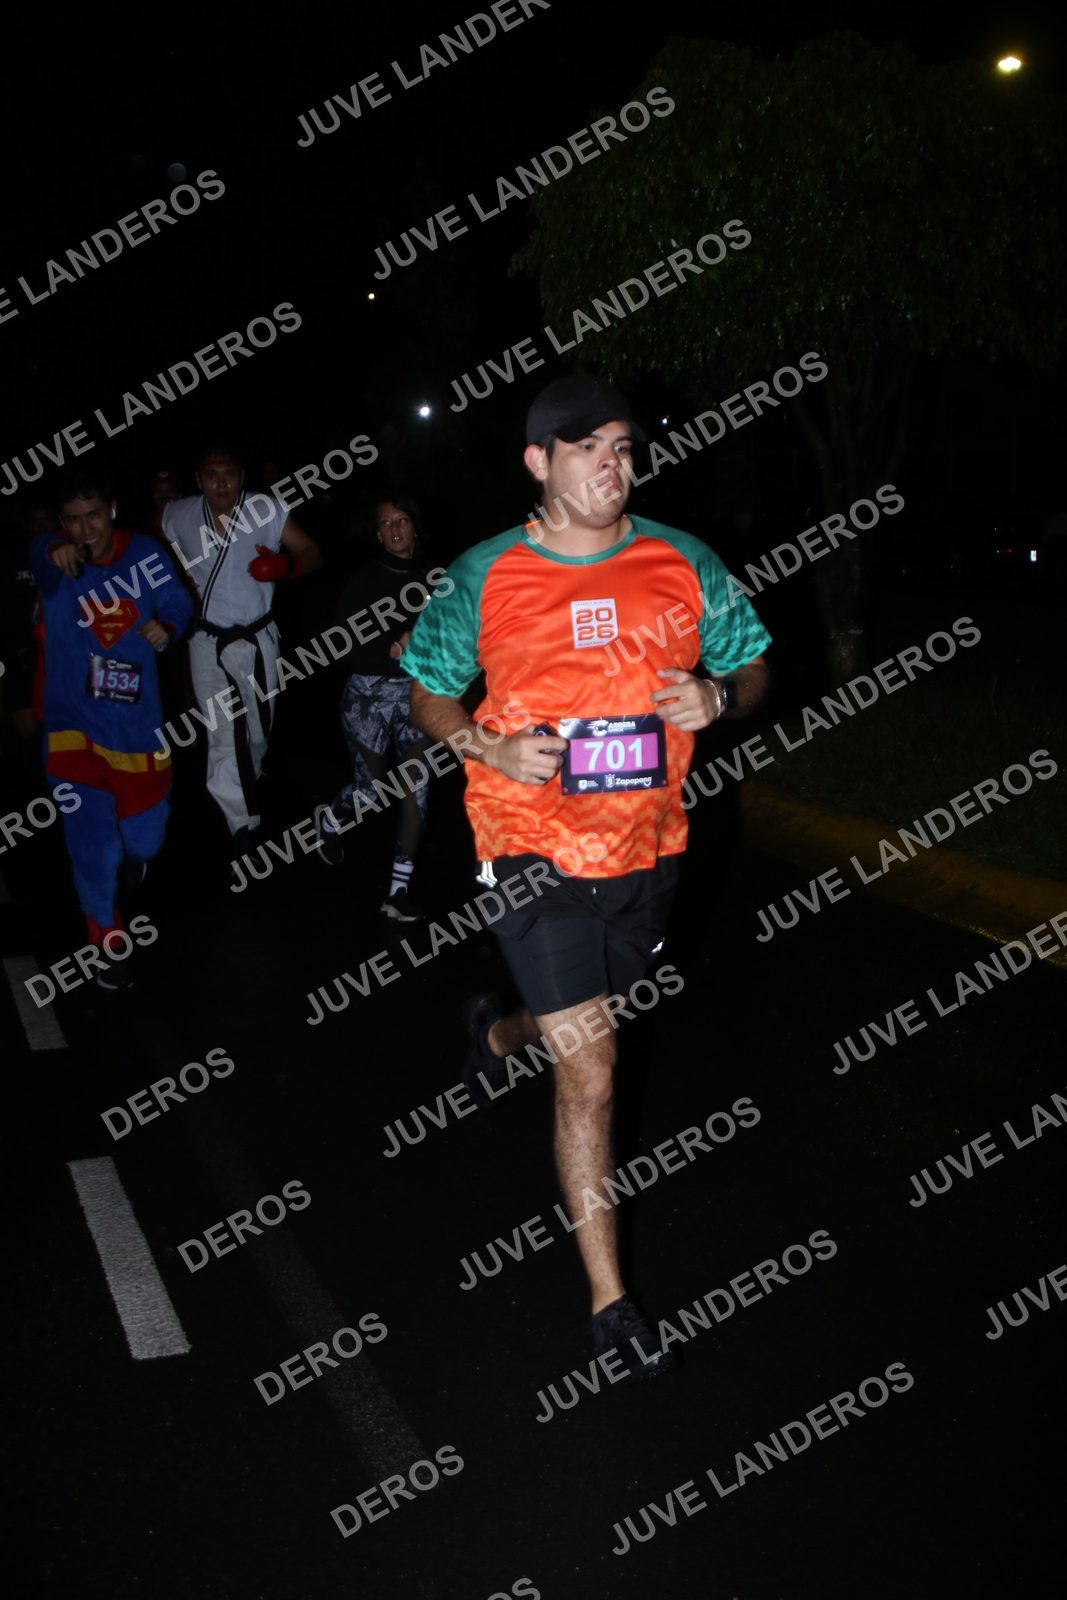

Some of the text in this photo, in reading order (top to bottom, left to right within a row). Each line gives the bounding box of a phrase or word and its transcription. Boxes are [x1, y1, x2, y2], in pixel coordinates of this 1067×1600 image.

[576, 607, 613, 624] 20
[577, 623, 615, 641] 26
[96, 670, 140, 691] 1534
[584, 737, 643, 771] 701
